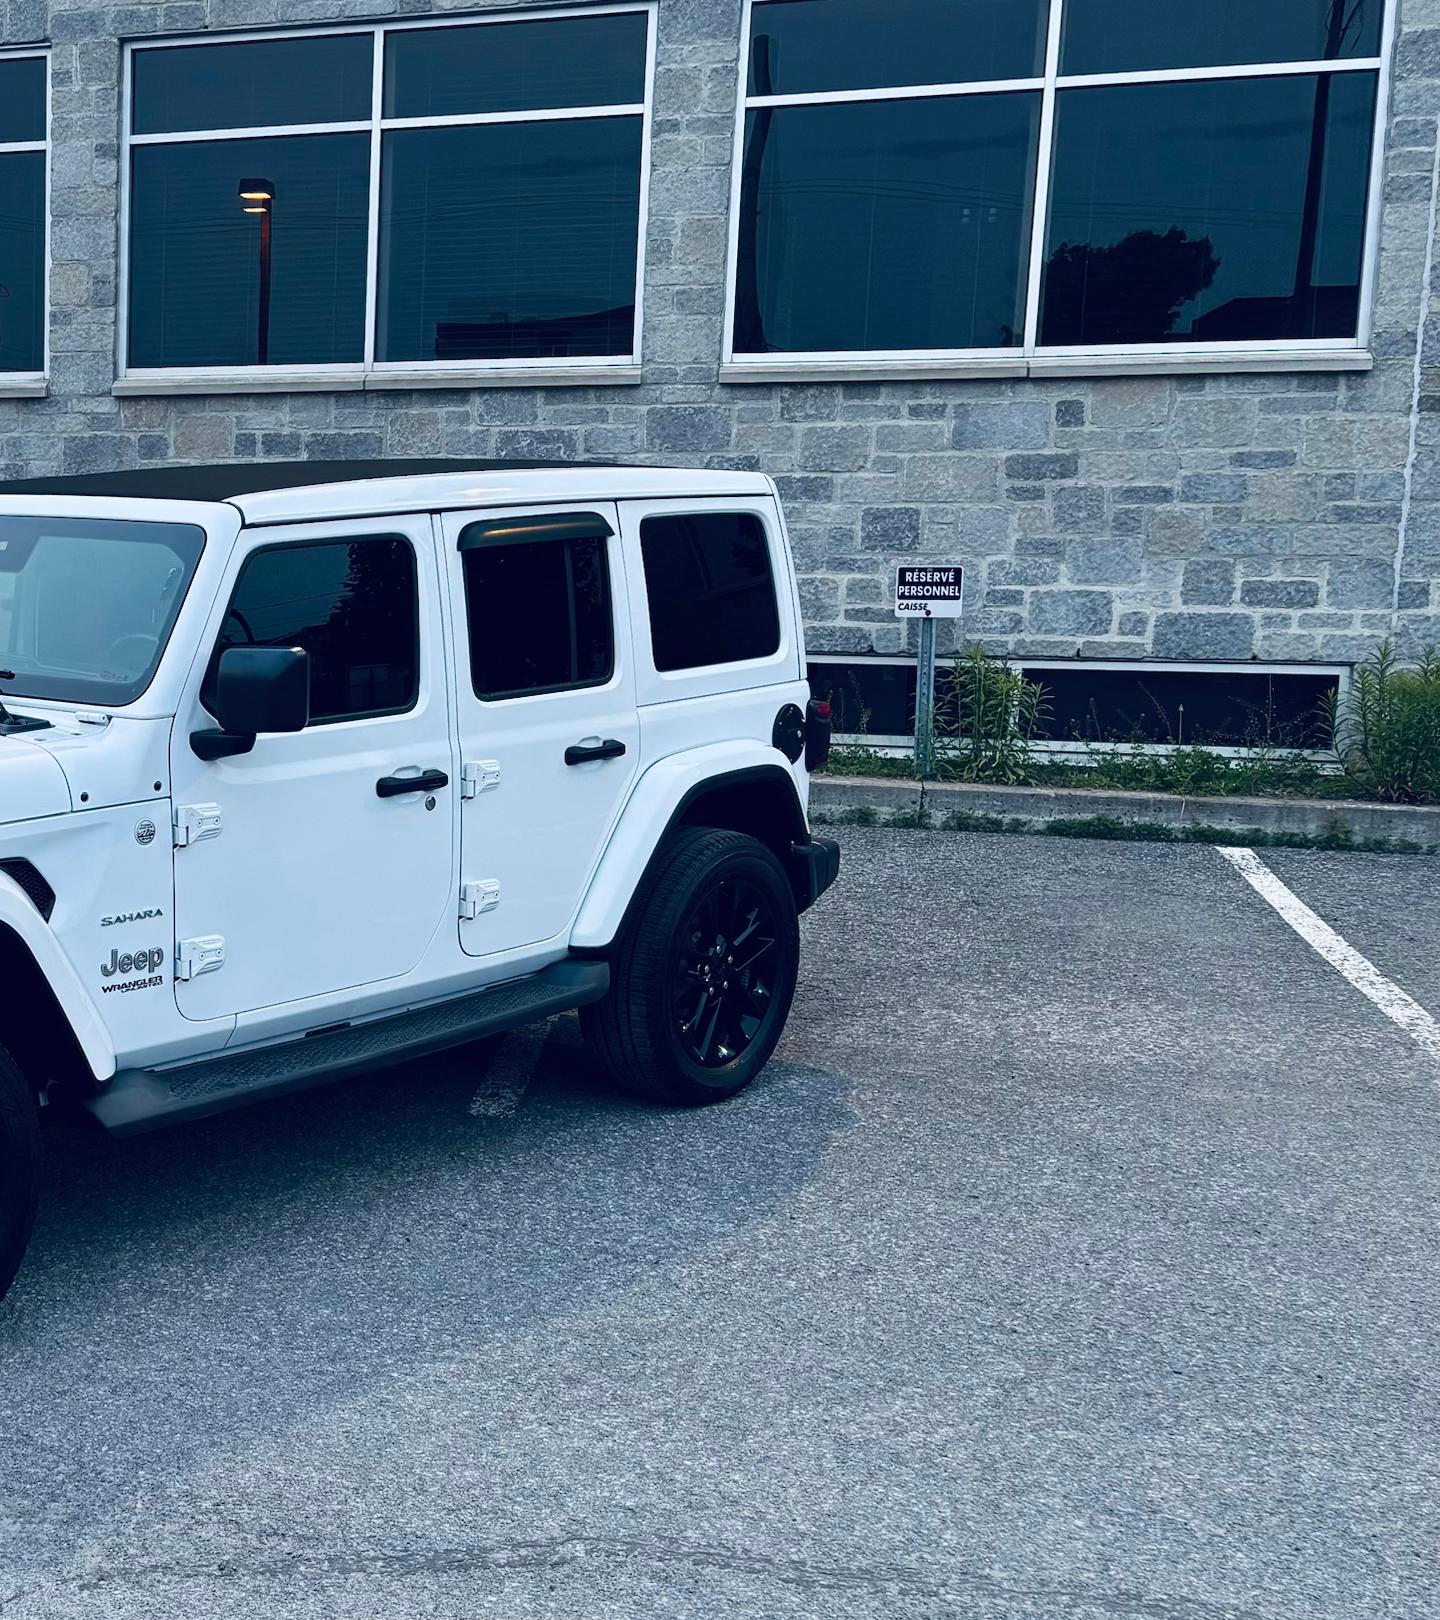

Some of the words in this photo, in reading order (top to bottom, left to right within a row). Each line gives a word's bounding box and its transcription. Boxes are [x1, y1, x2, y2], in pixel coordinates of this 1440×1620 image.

[905, 569, 955, 583] RÉSERVÉ
[898, 585, 960, 597] PERSONNEL
[898, 602, 929, 611] CAISSE
[100, 908, 164, 927] SAHARA
[100, 946, 164, 977] Jeep
[101, 975, 164, 993] WRANGLER
